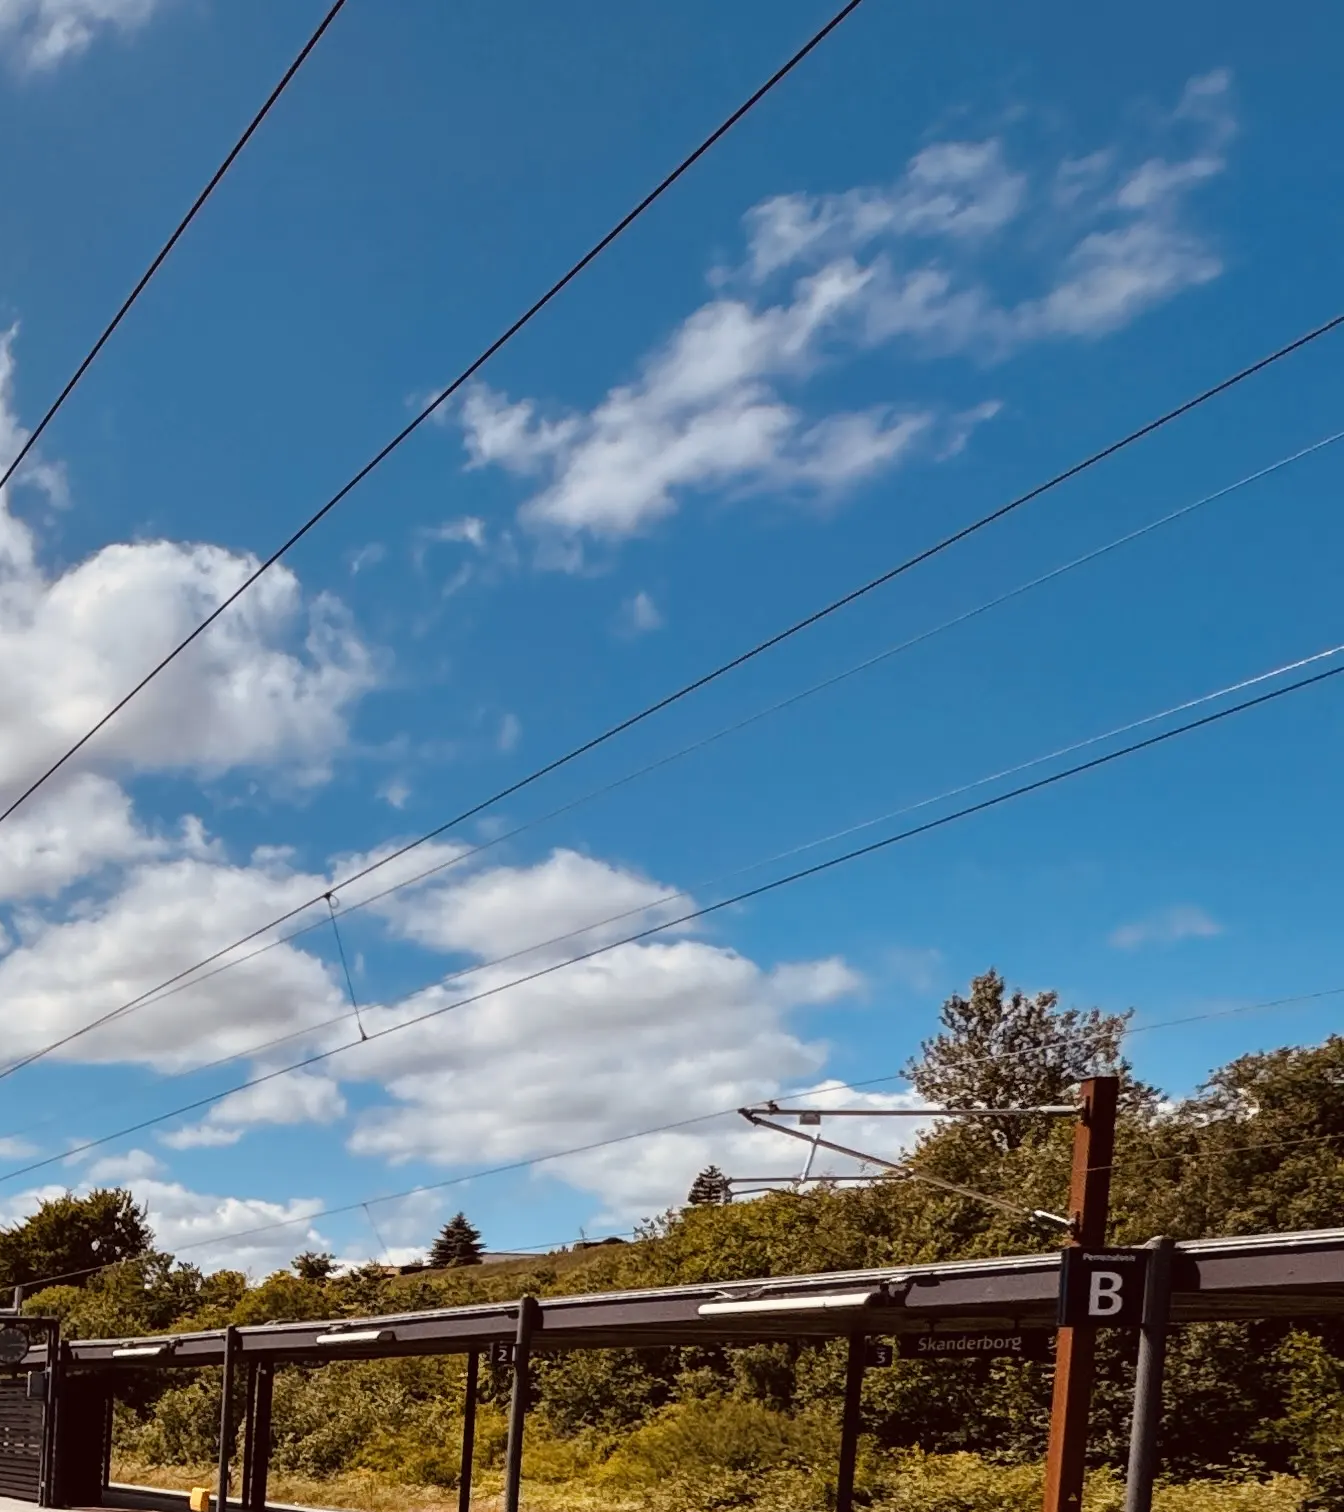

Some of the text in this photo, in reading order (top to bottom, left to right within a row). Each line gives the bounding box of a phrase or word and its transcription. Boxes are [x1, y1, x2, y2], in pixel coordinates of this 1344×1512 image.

[1088, 1271, 1123, 1316] B
[918, 1336, 1022, 1351] Skanderborg
[498, 1349, 508, 1362] 2
